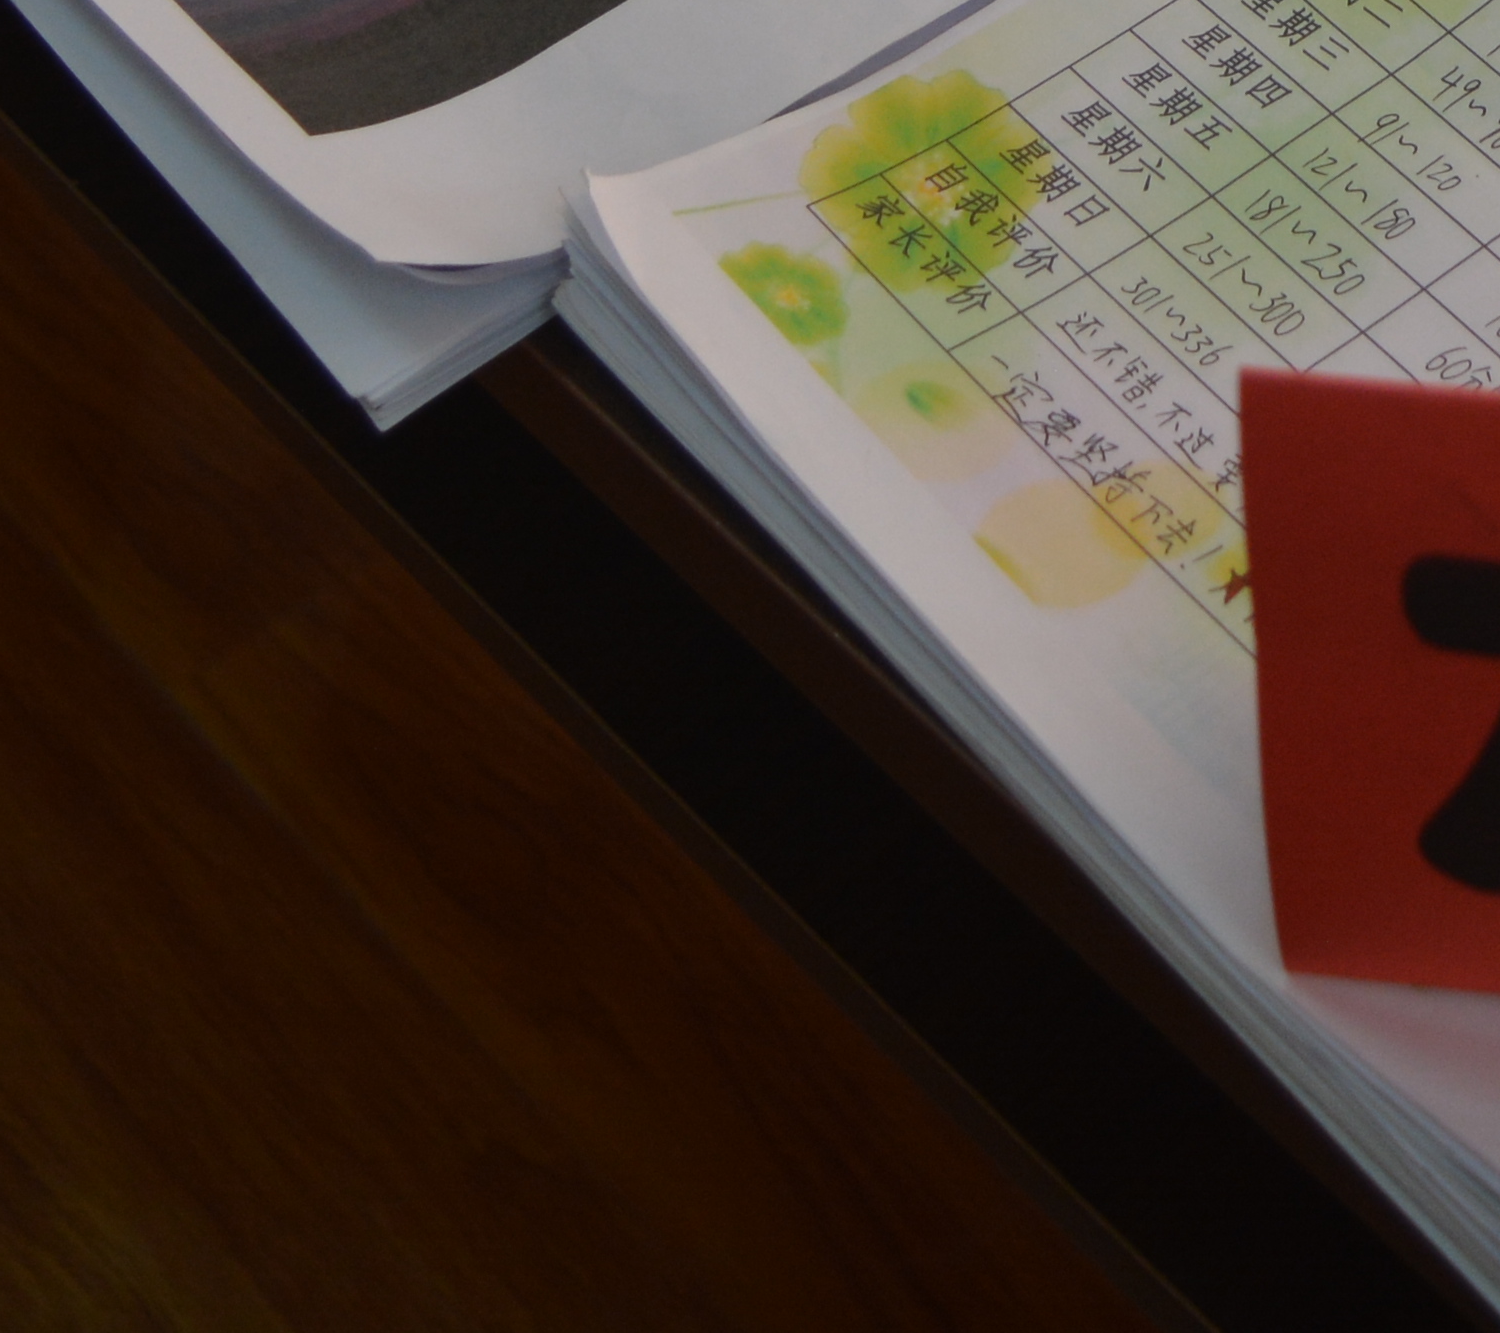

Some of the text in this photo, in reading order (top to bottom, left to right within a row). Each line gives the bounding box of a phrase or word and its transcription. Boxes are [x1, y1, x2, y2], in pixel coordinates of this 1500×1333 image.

[1120, 61, 1234, 152] 星期五
[1180, 23, 1294, 110] 星期四
[997, 137, 1123, 228] 星期日
[1059, 99, 1186, 193] 星期六
[855, 194, 1010, 316] 家长评价
[923, 162, 1078, 280] 自我评价
